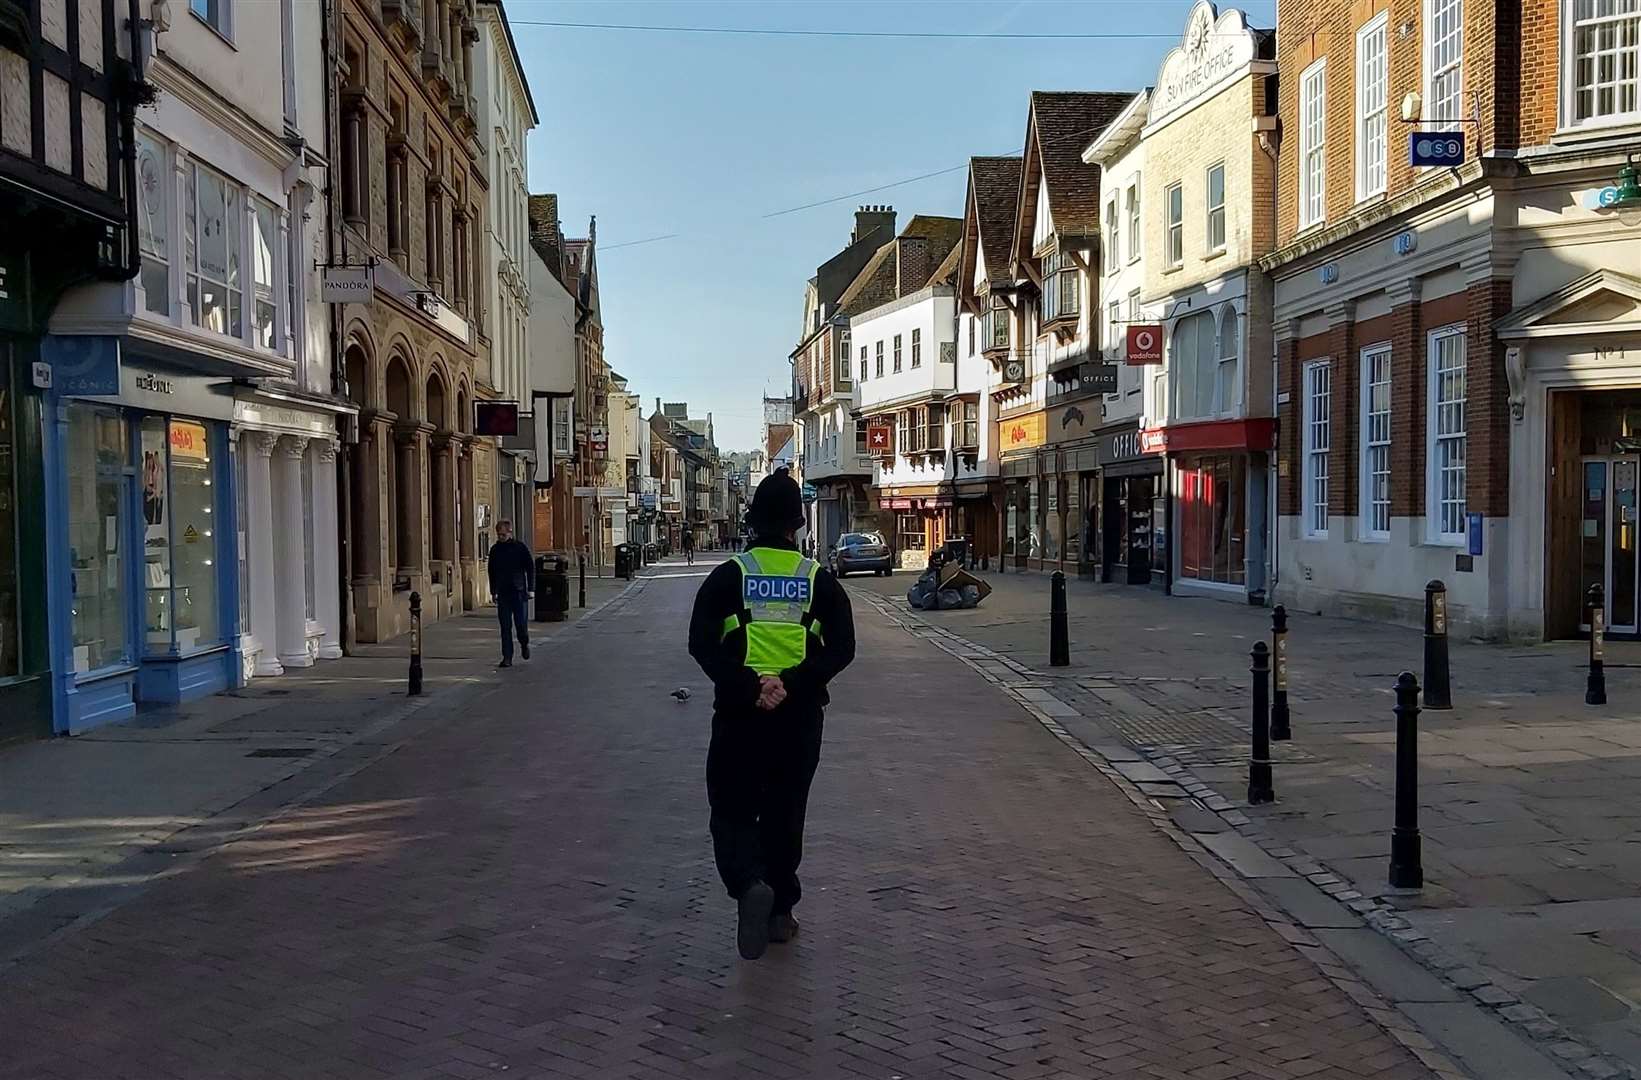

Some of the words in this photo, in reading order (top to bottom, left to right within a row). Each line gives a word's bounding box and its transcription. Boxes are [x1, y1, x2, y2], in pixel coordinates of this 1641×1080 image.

[1185, 65, 1202, 92] FIRE
[1204, 45, 1234, 79] OFFICE
[324, 281, 368, 289] PANDORA
[1129, 352, 1160, 360] vodafone
[1113, 433, 1140, 458] OFFIC
[747, 579, 808, 598] POLICE
